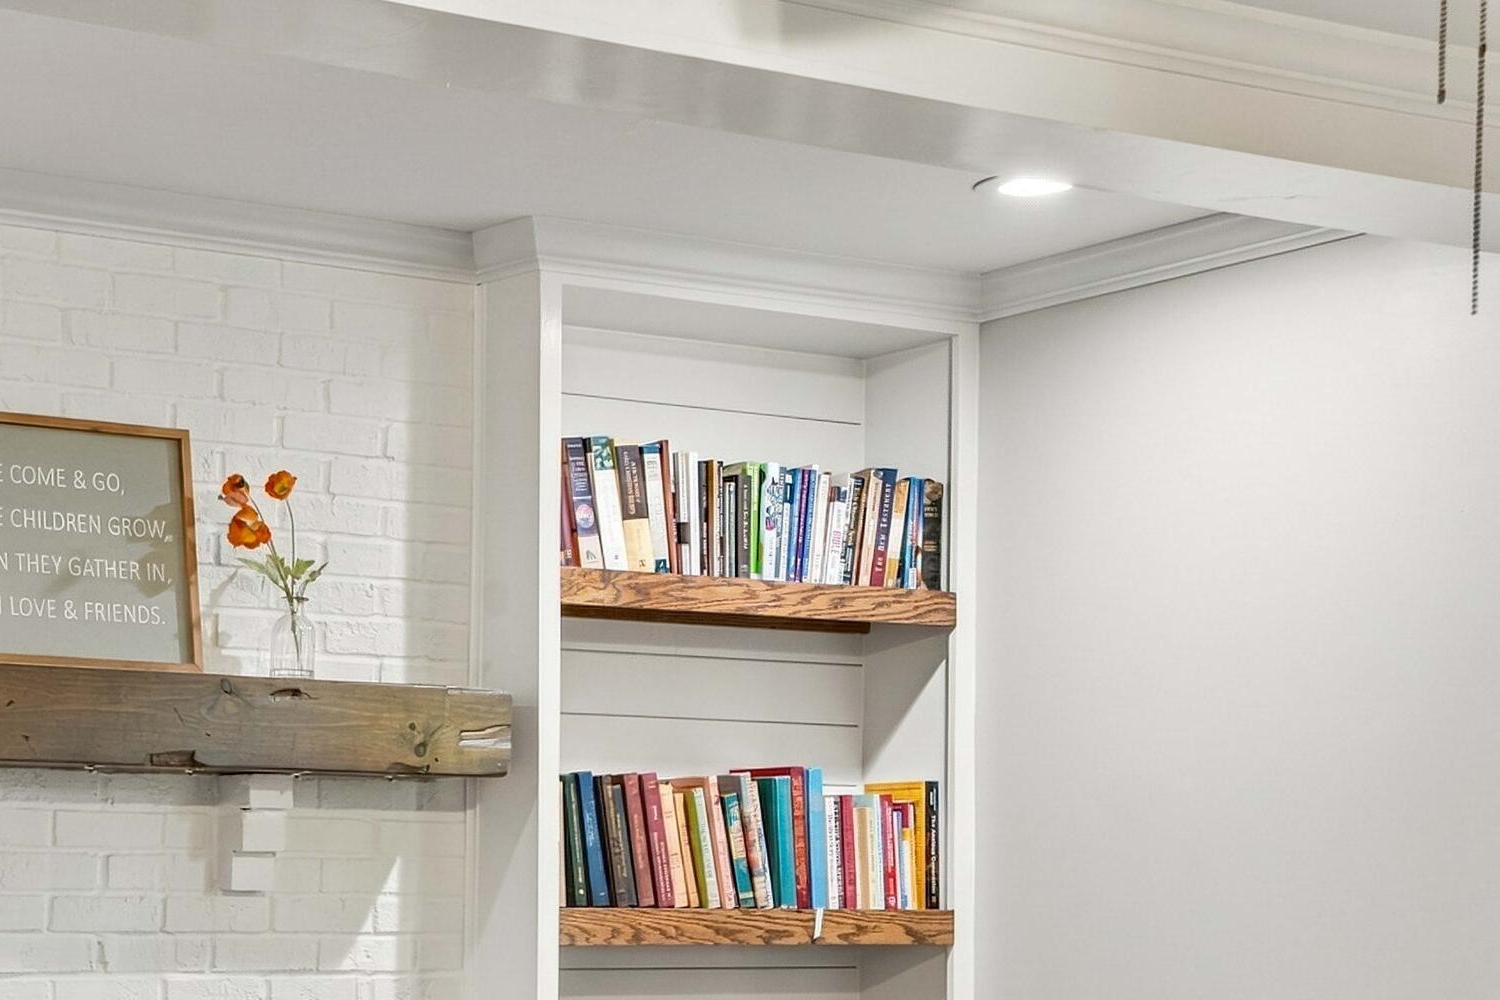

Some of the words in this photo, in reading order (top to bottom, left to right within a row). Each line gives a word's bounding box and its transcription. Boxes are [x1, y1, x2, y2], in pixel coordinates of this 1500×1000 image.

[10, 465, 66, 488] COME
[73, 470, 86, 490] &
[92, 472, 124, 496] GO,
[11, 508, 101, 535] CHILDREN
[107, 517, 172, 543] GROW,
[15, 553, 61, 576] THEY
[68, 557, 140, 580] GATHER
[146, 563, 172, 584] IN,
[10, 596, 56, 619] LOVE
[64, 600, 78, 619] &
[85, 602, 166, 625] FRIENDS.
